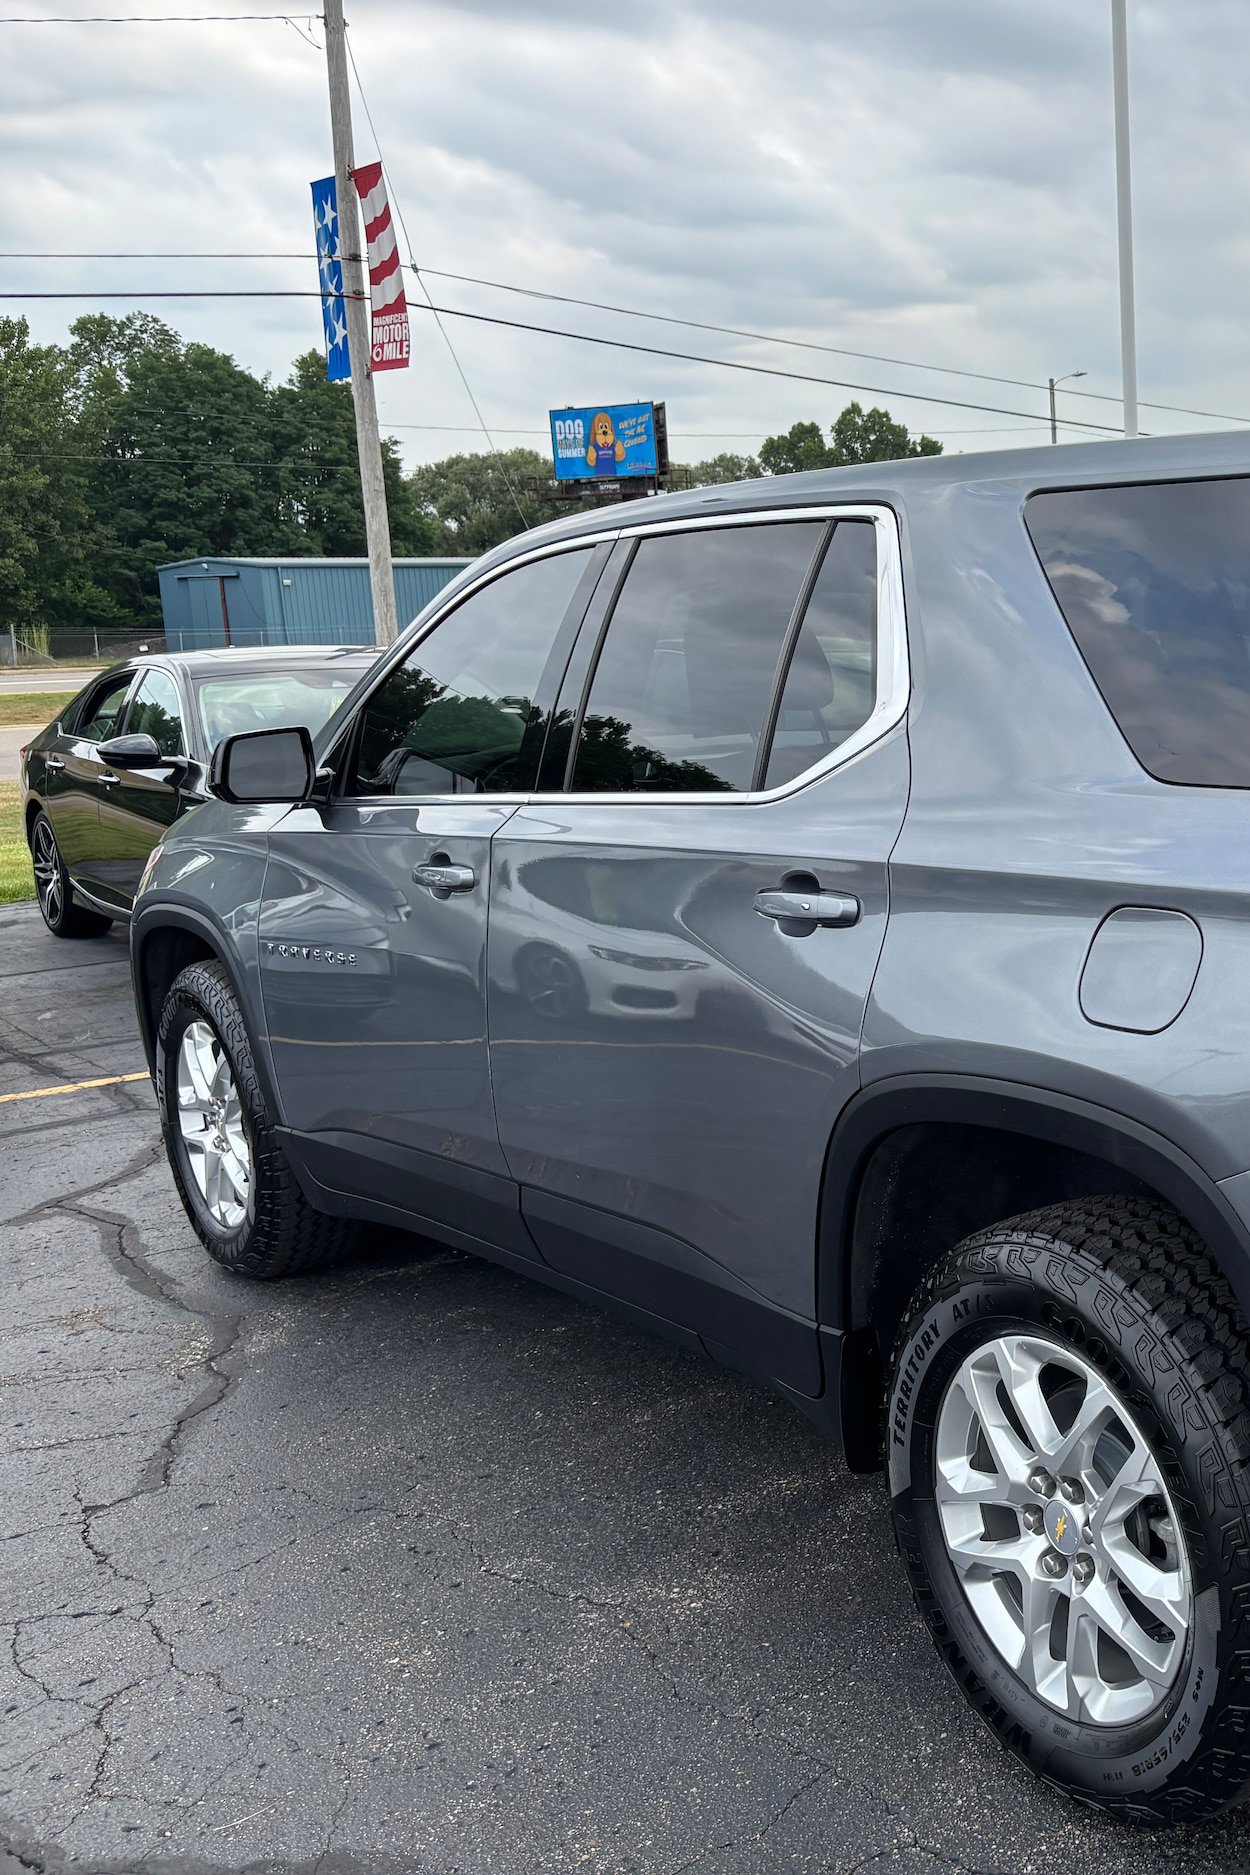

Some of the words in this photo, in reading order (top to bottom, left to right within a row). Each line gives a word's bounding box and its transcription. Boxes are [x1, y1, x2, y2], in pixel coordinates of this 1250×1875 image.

[373, 313, 408, 326] MAGNIFICENT
[373, 322, 409, 345] MOTOR
[383, 341, 409, 361] MILE
[555, 418, 584, 441] DOG
[558, 447, 587, 459] SUMMER
[267, 943, 357, 966] TRAVERSE
[893, 1318, 942, 1448] TERRITORY
